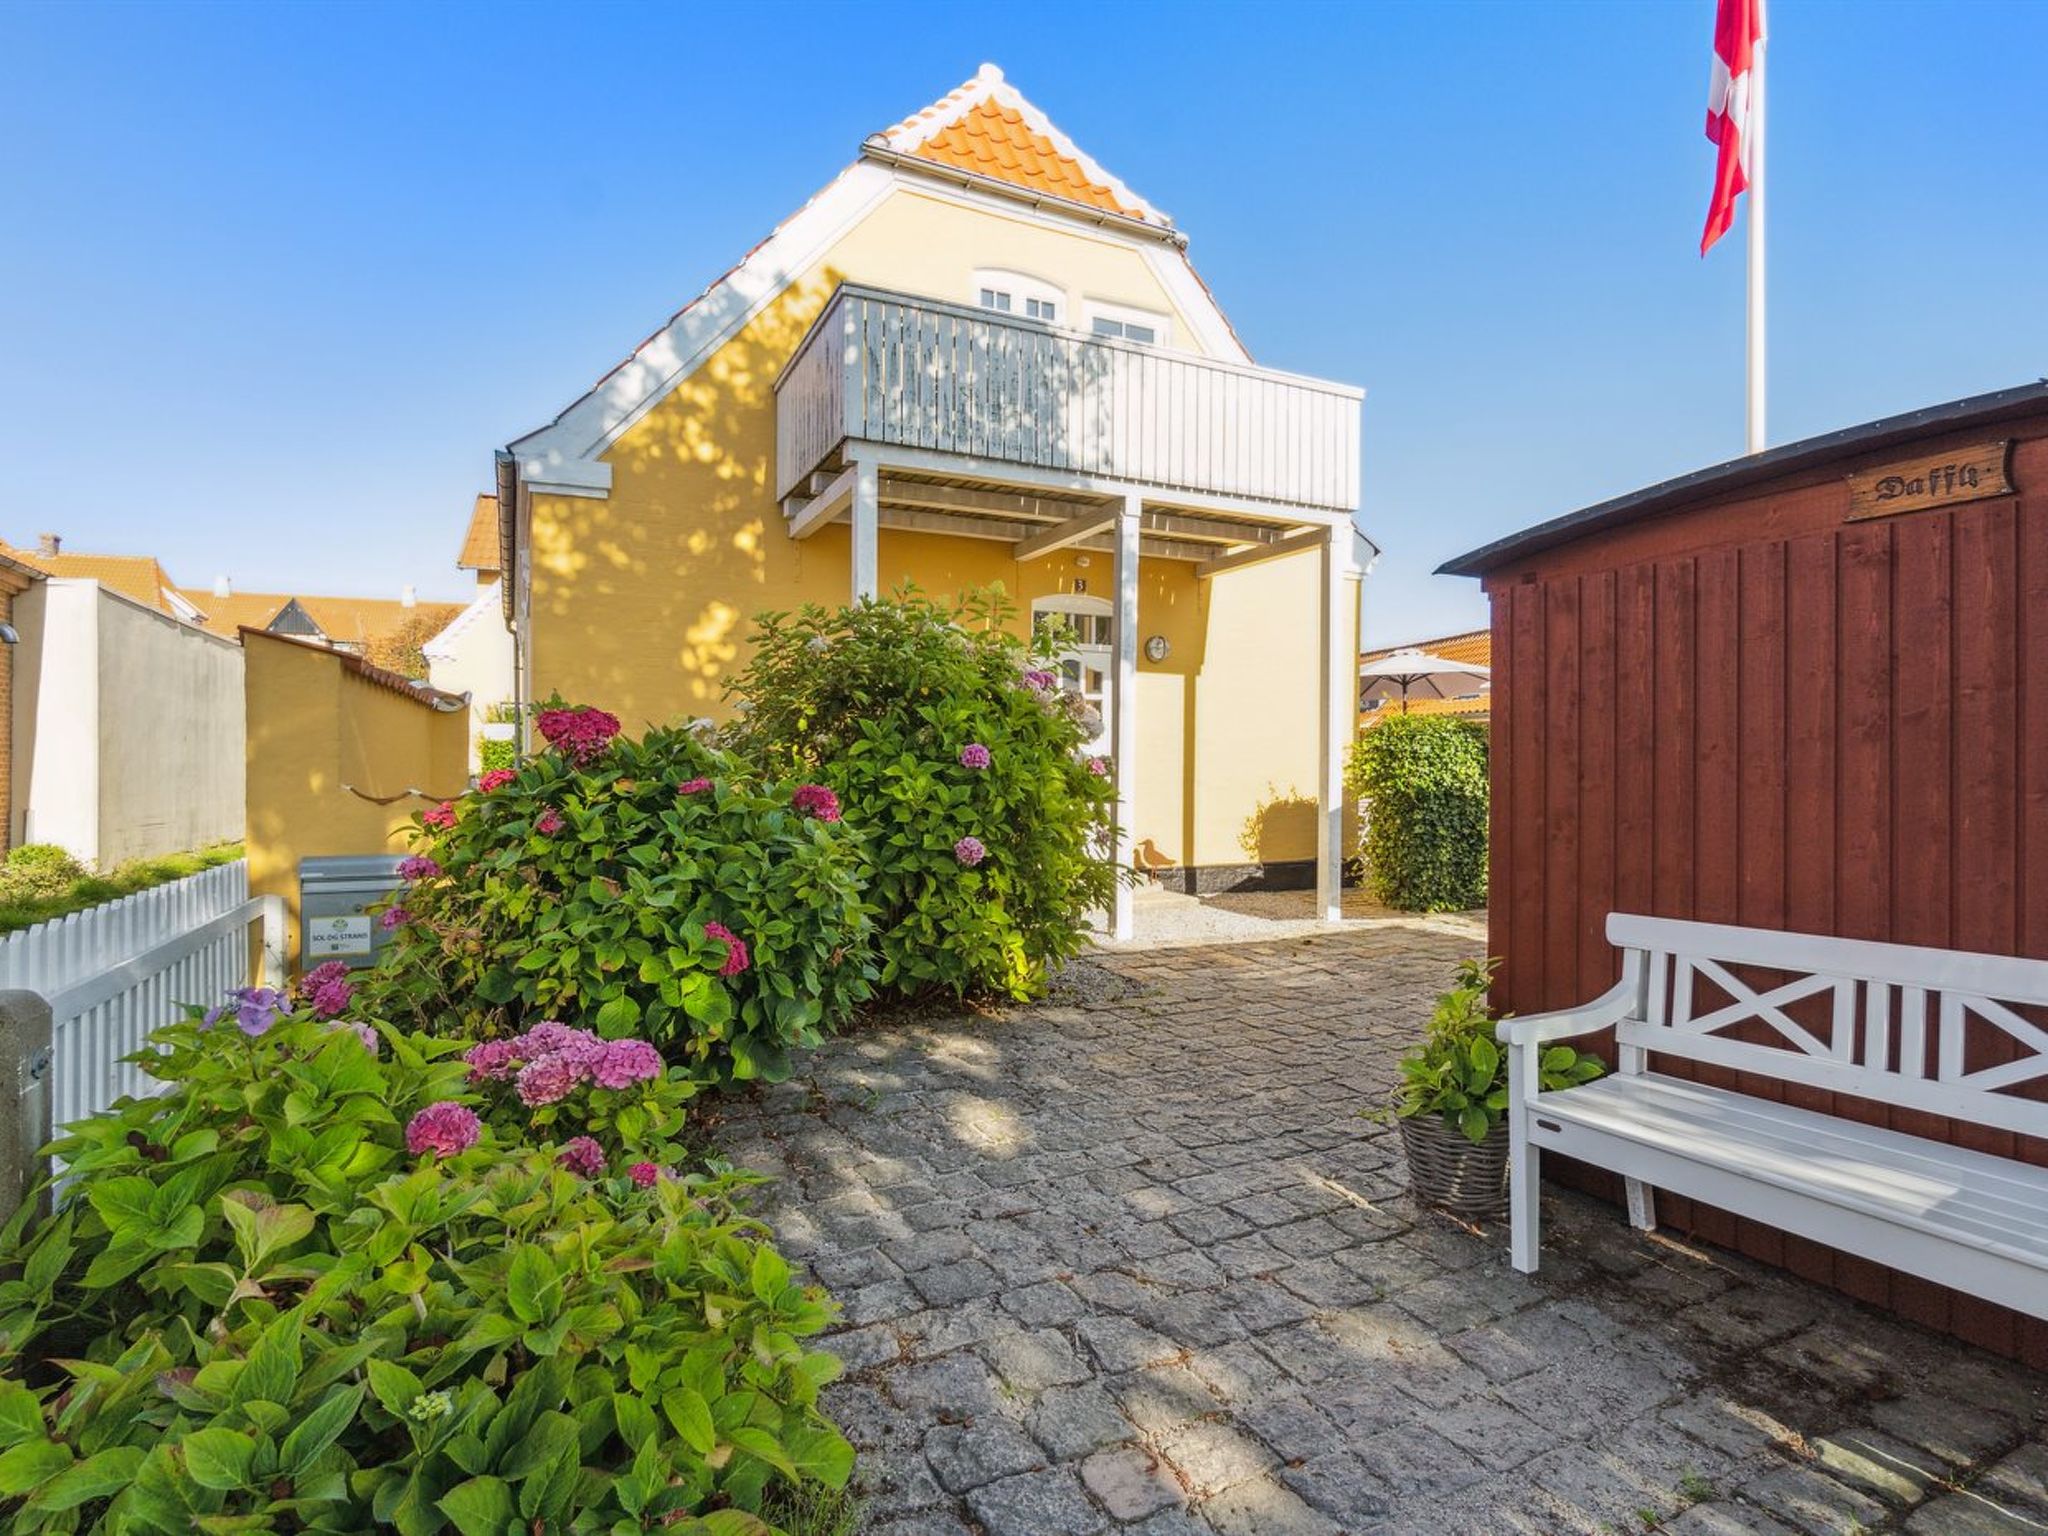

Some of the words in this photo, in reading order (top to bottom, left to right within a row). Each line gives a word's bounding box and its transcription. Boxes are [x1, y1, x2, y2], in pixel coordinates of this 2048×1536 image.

[313, 934, 325, 942] SOL
[327, 933, 338, 941] OG
[340, 932, 368, 940] STRAND
